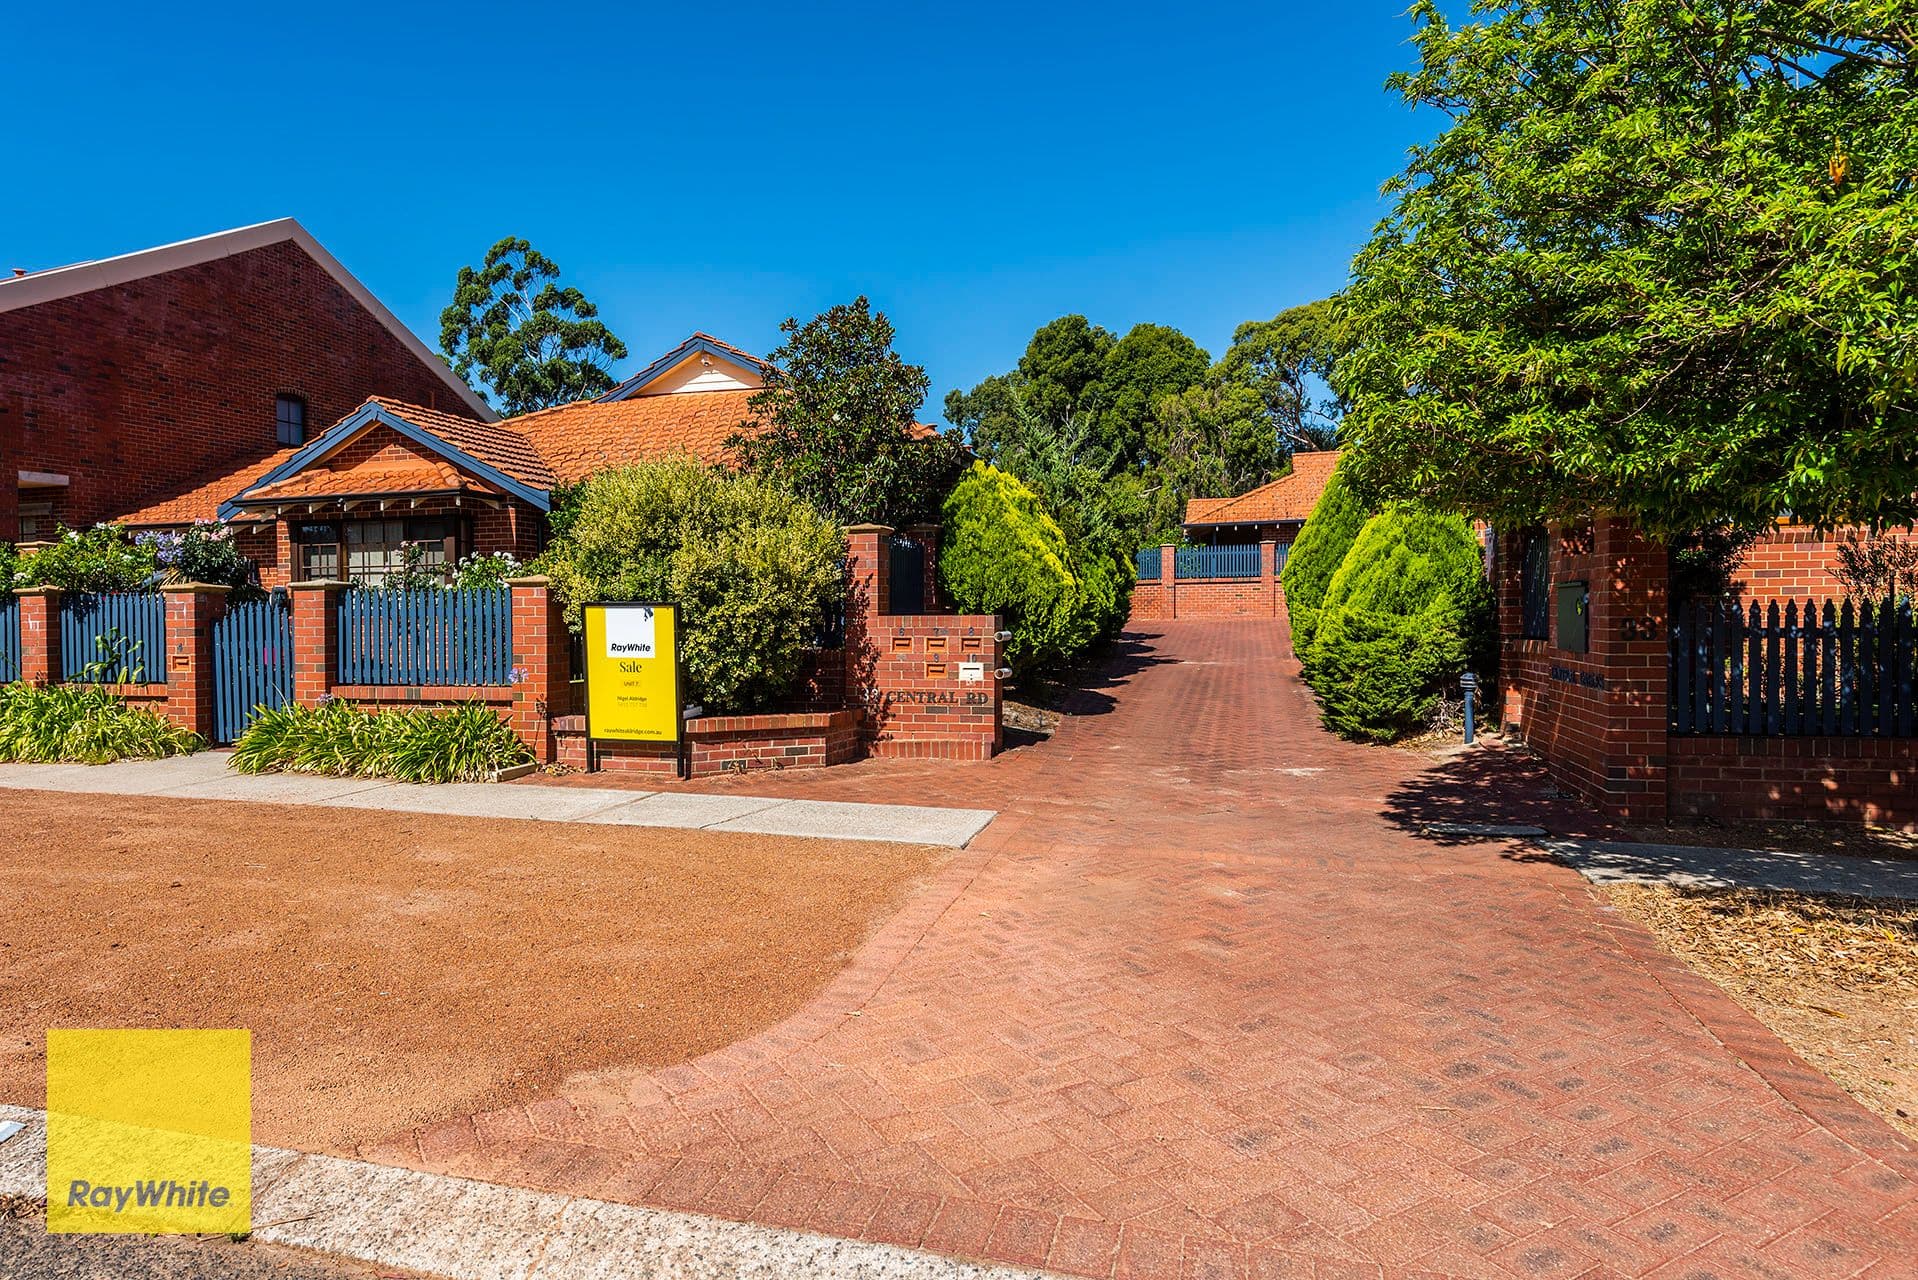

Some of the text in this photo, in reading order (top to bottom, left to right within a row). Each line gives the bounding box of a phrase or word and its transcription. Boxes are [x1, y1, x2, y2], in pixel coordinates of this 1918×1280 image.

[610, 643, 651, 653] RayWhite
[619, 661, 643, 673] Sale
[886, 691, 959, 704] CENTRAL
[965, 692, 989, 705] RD
